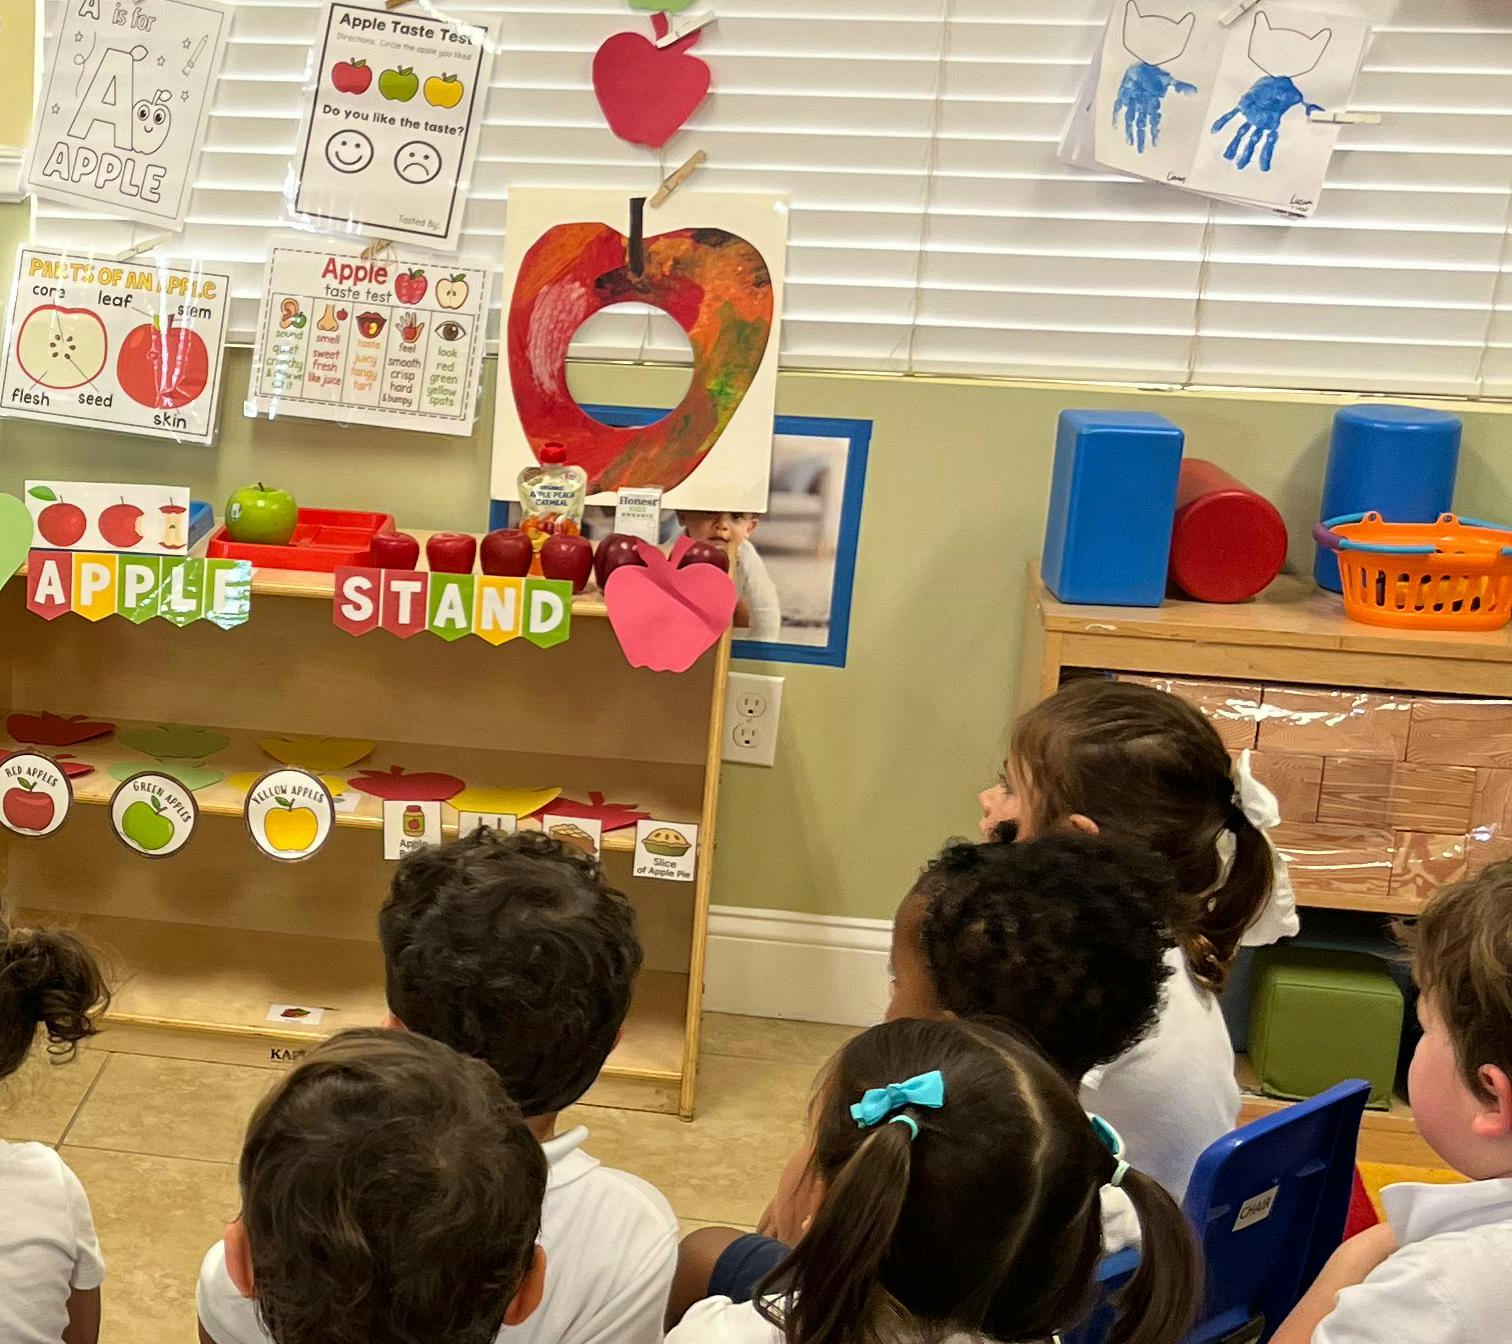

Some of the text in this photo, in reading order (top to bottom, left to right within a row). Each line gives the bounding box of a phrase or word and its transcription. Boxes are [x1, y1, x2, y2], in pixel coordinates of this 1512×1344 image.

[112, 2, 127, 27] is
[131, 7, 156, 32] for
[339, 13, 386, 31] Apple
[391, 20, 434, 39] Taste
[67, 47, 135, 152] A
[323, 104, 464, 136] Do you like the taste?
[42, 141, 167, 203] APPLE
[398, 214, 425, 227] Tasted
[321, 257, 388, 287] Apple
[98, 267, 123, 286] OF
[126, 272, 152, 291] AN
[156, 275, 217, 300] PPLE
[98, 290, 133, 308] leaf
[325, 284, 392, 303] taste test
[316, 335, 340, 344] smell
[313, 350, 340, 360] sweet
[399, 344, 416, 353] feel
[438, 347, 457, 357] look
[313, 359, 338, 372] fresh
[353, 355, 377, 367] juicy
[388, 357, 421, 368] smooth
[436, 362, 455, 372] red
[390, 370, 415, 384] crisp
[429, 373, 457, 385] green
[353, 381, 373, 392] tart
[390, 381, 412, 394] hard
[427, 385, 456, 397] yellow
[12, 388, 50, 406] flesh
[78, 393, 113, 407] seed
[429, 396, 454, 407] spots
[153, 413, 187, 429] skin
[619, 496, 659, 507] Honest
[340, 575, 564, 635] STAND
[5, 766, 59, 788] RED APPLES
[251, 783, 325, 806] YELLOW APPLES
[132, 779, 192, 824] GREEN APPLES
[653, 857, 677, 868] Slice
[637, 866, 691, 878] of Apple Pie
